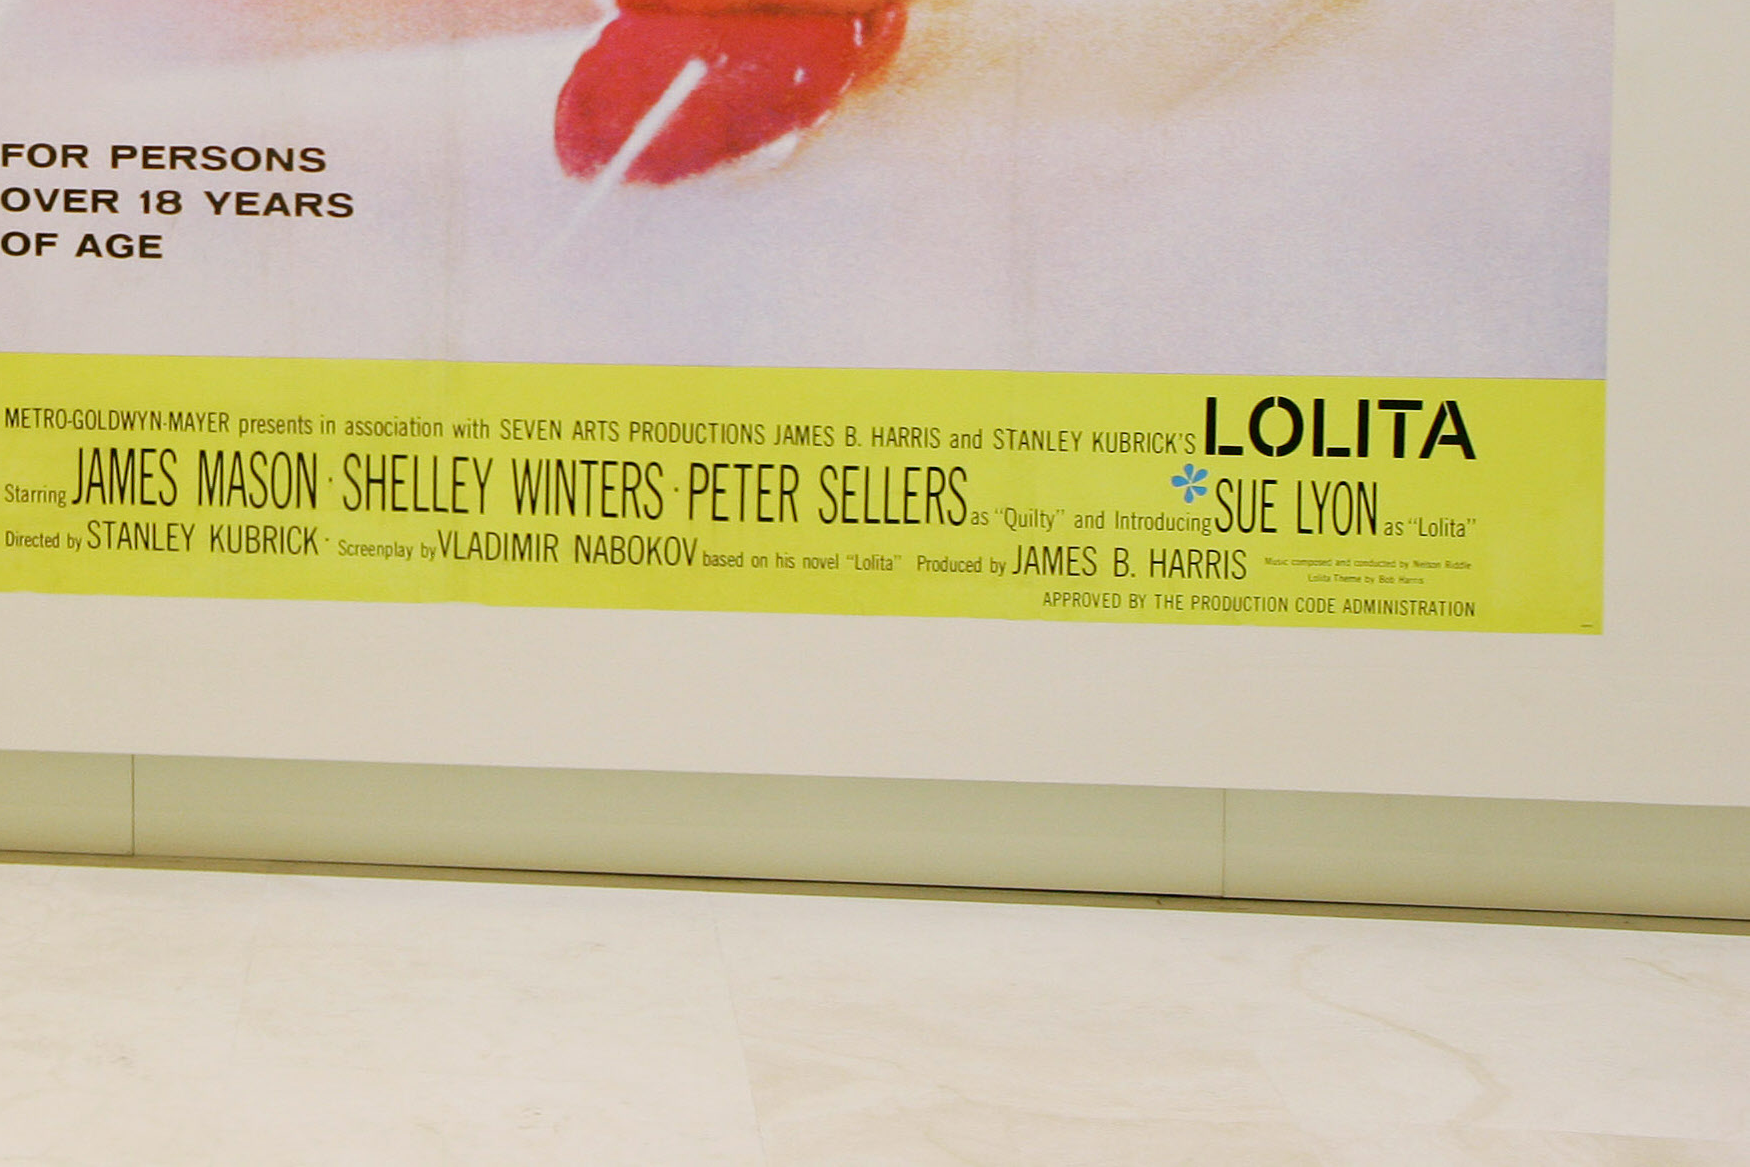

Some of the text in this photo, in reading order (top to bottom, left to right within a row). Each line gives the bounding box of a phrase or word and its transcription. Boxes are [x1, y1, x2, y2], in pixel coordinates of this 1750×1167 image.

[2, 143, 326, 172] FOR PERSONS
[1, 187, 353, 217] OVER 18 YEARS
[1, 232, 162, 258] OF AGE
[5, 397, 1476, 459] METRO-GOLDWYN-MAYER presents in association with SEVEN ARTS PRODUCTIONS JAMES B. HARRIS and STANLEY KUBRICK'S LOLITA
[5, 484, 66, 508] Starring
[72, 448, 177, 506] JAMES
[198, 450, 316, 509] MASON
[343, 453, 492, 514] SHELLEY
[512, 459, 663, 520] WINTERS
[689, 463, 799, 522] PETER
[819, 465, 966, 526] SELLERS
[971, 512, 988, 525] as
[1074, 511, 1104, 529] and
[1116, 511, 1211, 536] Introducing
[1215, 478, 1277, 533] SUE
[1298, 481, 1376, 536] LYON
[1384, 522, 1403, 536] as
[6, 531, 59, 548] Directed
[67, 533, 82, 552] by
[88, 520, 195, 551] STANLEY
[211, 525, 318, 554] KUBRICK
[338, 539, 413, 561] Screenplay
[421, 543, 436, 561] by
[438, 530, 558, 562] VLADIMIR
[575, 535, 697, 566] NABOKOV
[703, 551, 743, 567] based
[751, 556, 768, 568] on
[776, 552, 795, 568] his
[803, 553, 839, 569] novel
[917, 555, 982, 573] Produced
[990, 557, 1006, 577] by
[1012, 545, 1096, 576] JAMES
[1114, 548, 1135, 577] B.
[1150, 549, 1246, 579] HARRIS
[1043, 592, 1475, 616] APPROVED BY THE PRODUCTION CODE ADMINISTRATION
